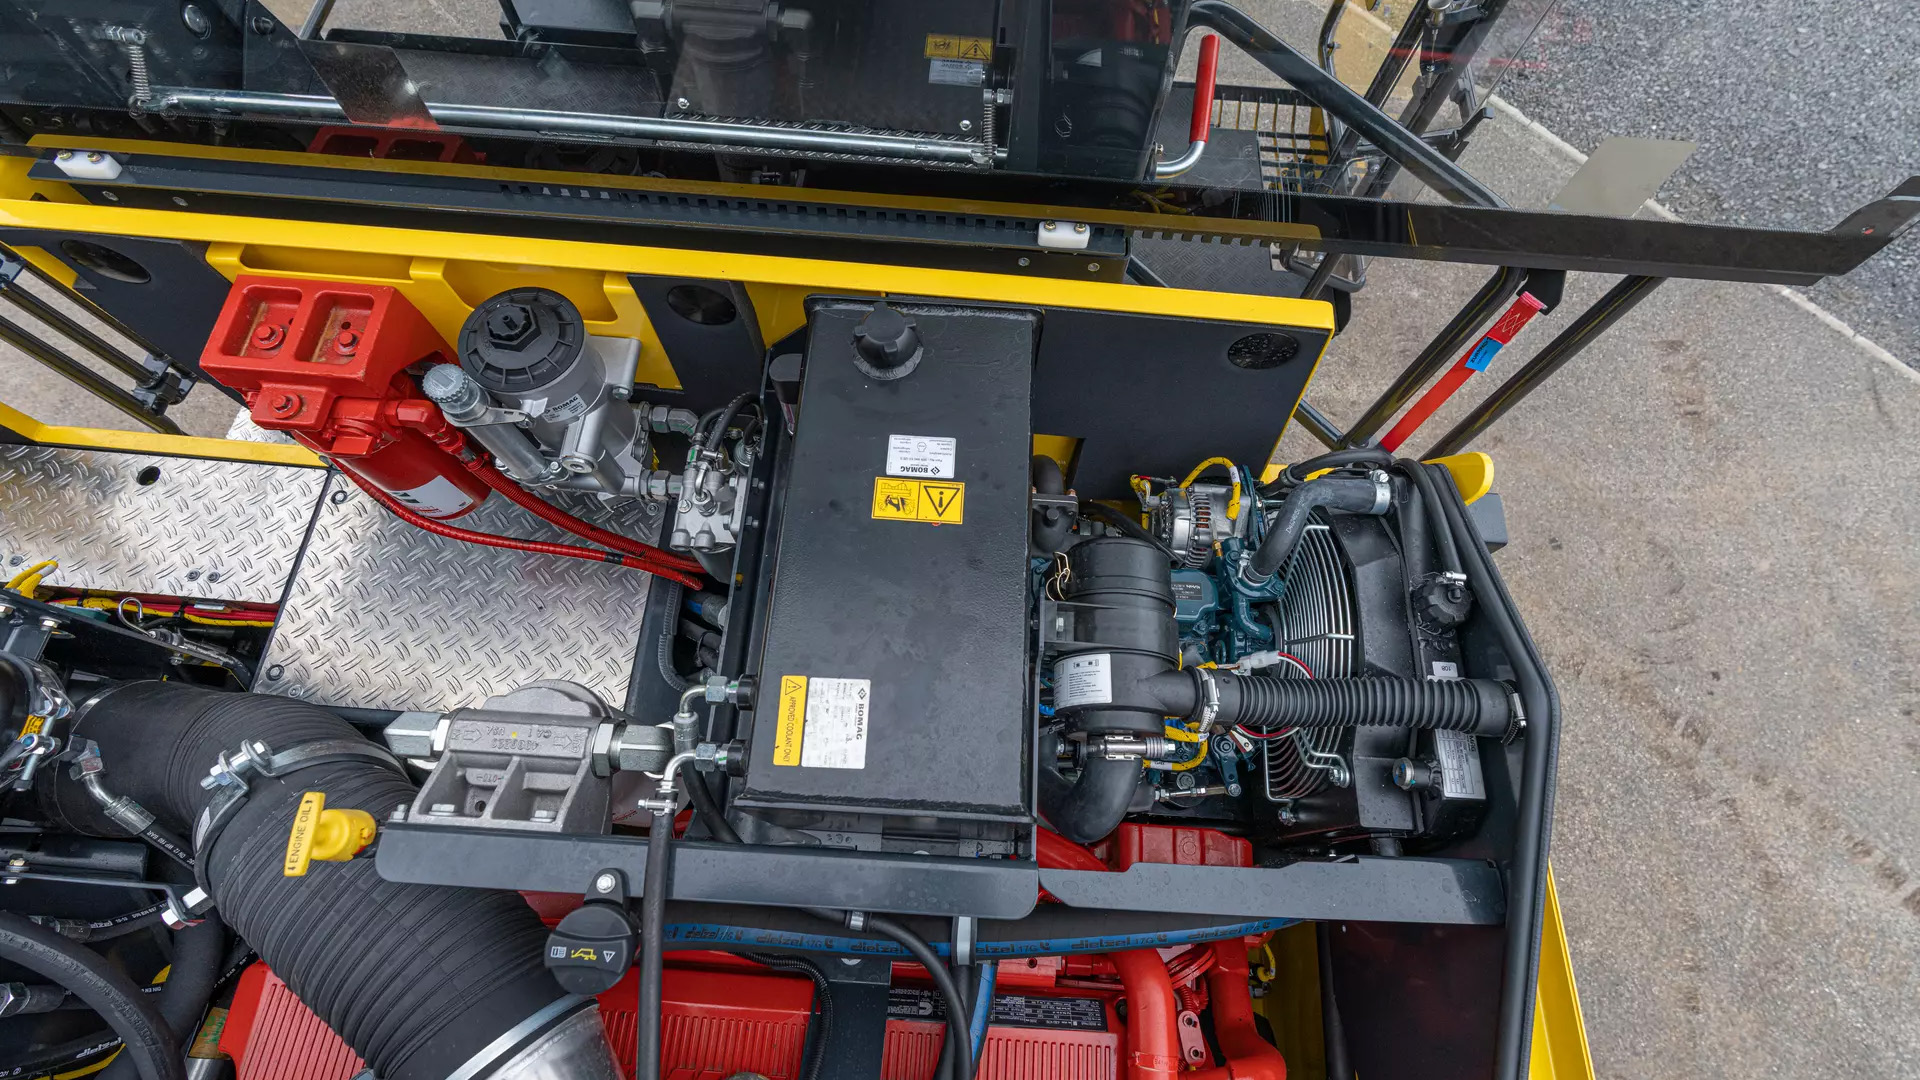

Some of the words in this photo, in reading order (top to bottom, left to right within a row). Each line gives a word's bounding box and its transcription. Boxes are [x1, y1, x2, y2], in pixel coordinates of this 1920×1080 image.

[552, 396, 578, 411] BOMAG
[788, 696, 796, 721] APPROVED
[856, 703, 864, 740] BOMAG
[785, 723, 794, 747] COOLANT
[1469, 735, 1477, 752] MAG
[783, 749, 791, 762] ONLY
[147, 831, 159, 839] BAR
[289, 826, 306, 863] ENGINE
[300, 805, 312, 823] OIL
[976, 943, 1015, 954] etzel
[1018, 944, 1038, 952] 17G
[1071, 936, 1130, 949] dietzel
[1135, 937, 1154, 945] 17G
[76, 1036, 122, 1059] dietzel
